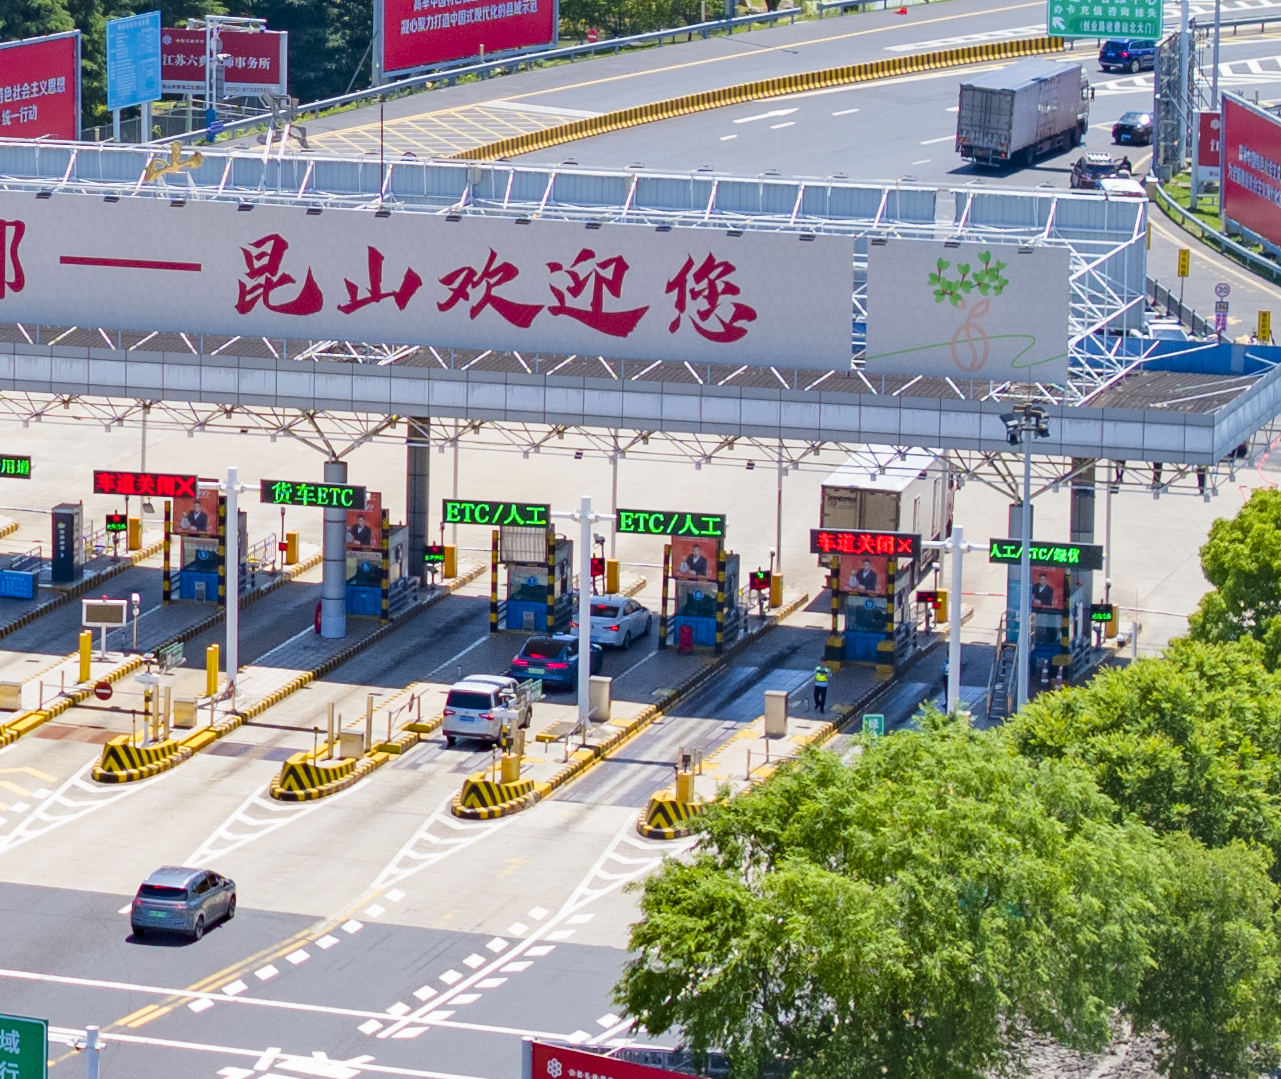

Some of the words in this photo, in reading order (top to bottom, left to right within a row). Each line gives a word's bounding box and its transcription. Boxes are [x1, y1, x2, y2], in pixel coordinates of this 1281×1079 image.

[1053, 4, 1076, 15] 办卡
[1080, 5, 1103, 16] 充值
[1107, 6, 1130, 17] 咨询
[162, 53, 272, 71] 江苏六典师事务所
[1218, 286, 1229, 294] 30
[96, 471, 177, 496] 车道关闭
[272, 481, 354, 508] 货车ETC
[446, 502, 548, 526] ETC/人工
[619, 511, 723, 536] ETC/人工
[816, 531, 896, 555] 车道关闭
